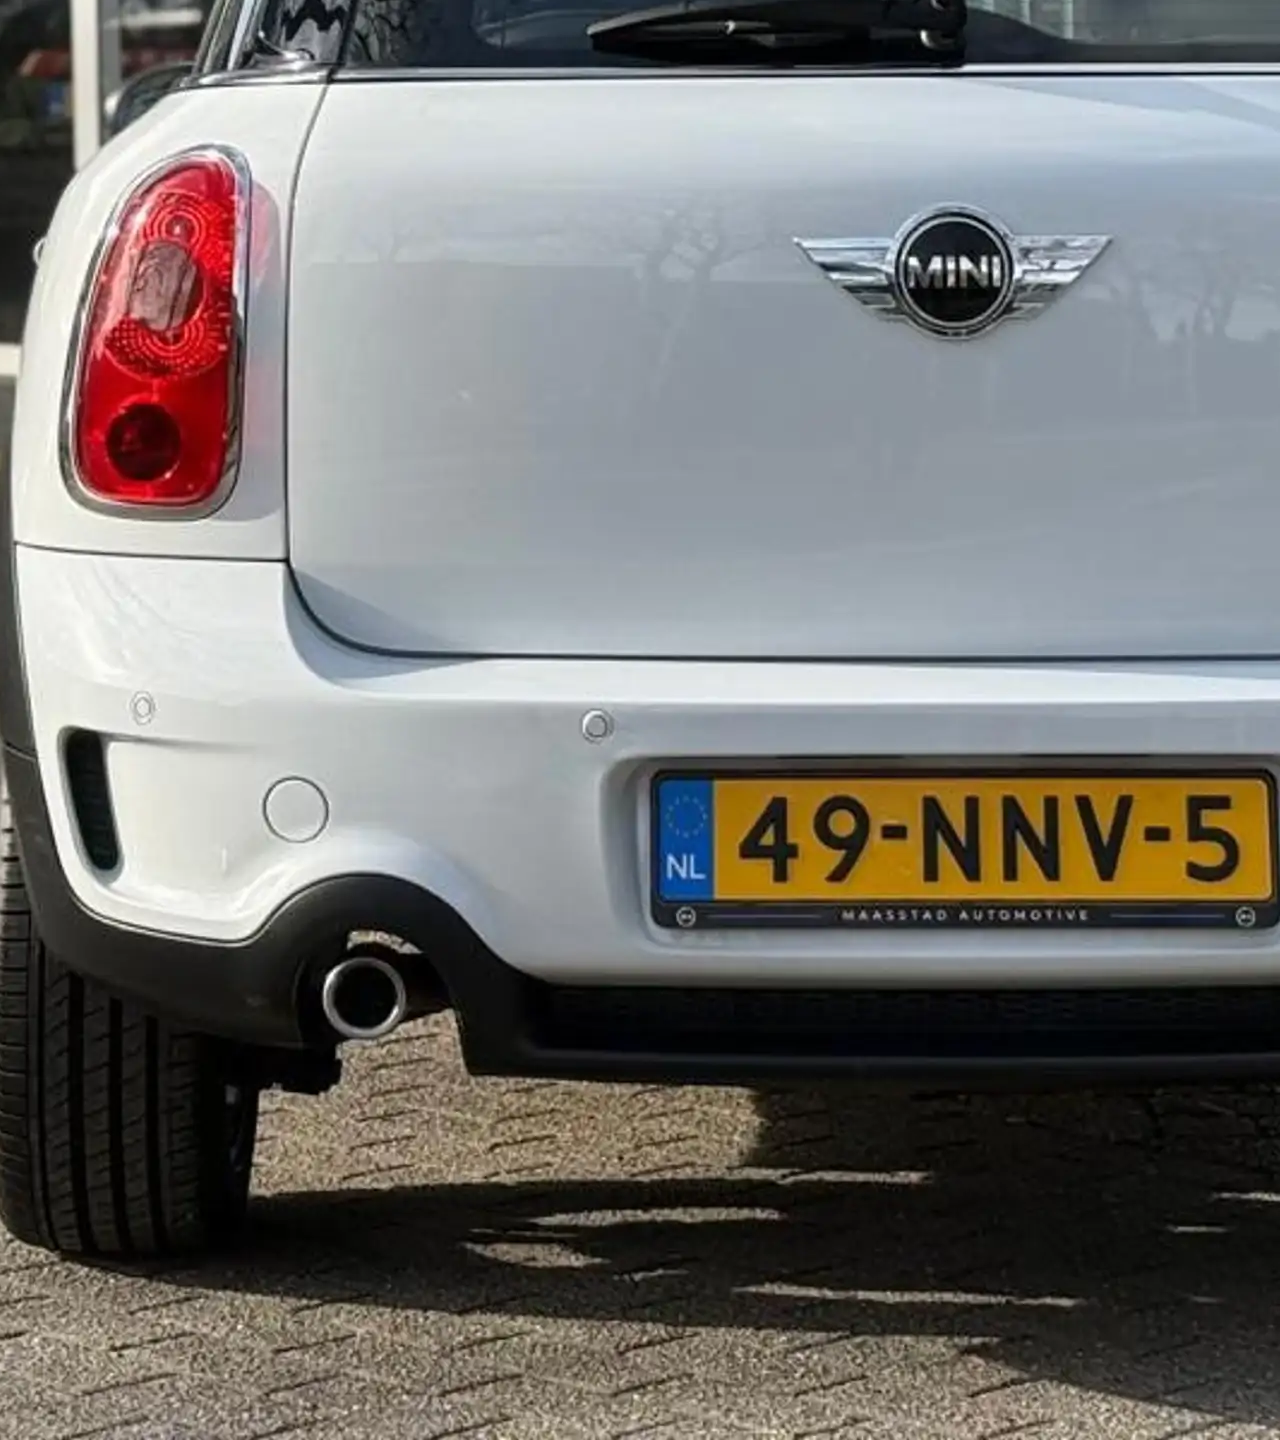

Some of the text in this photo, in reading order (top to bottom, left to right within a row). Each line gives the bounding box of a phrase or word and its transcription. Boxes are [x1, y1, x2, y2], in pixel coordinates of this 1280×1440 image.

[907, 254, 1002, 289] MINI
[738, 794, 1241, 883] 49-NNV-5
[666, 854, 707, 881] NL
[841, 909, 1090, 922] MAASSTAD AUTOMOTIVE
